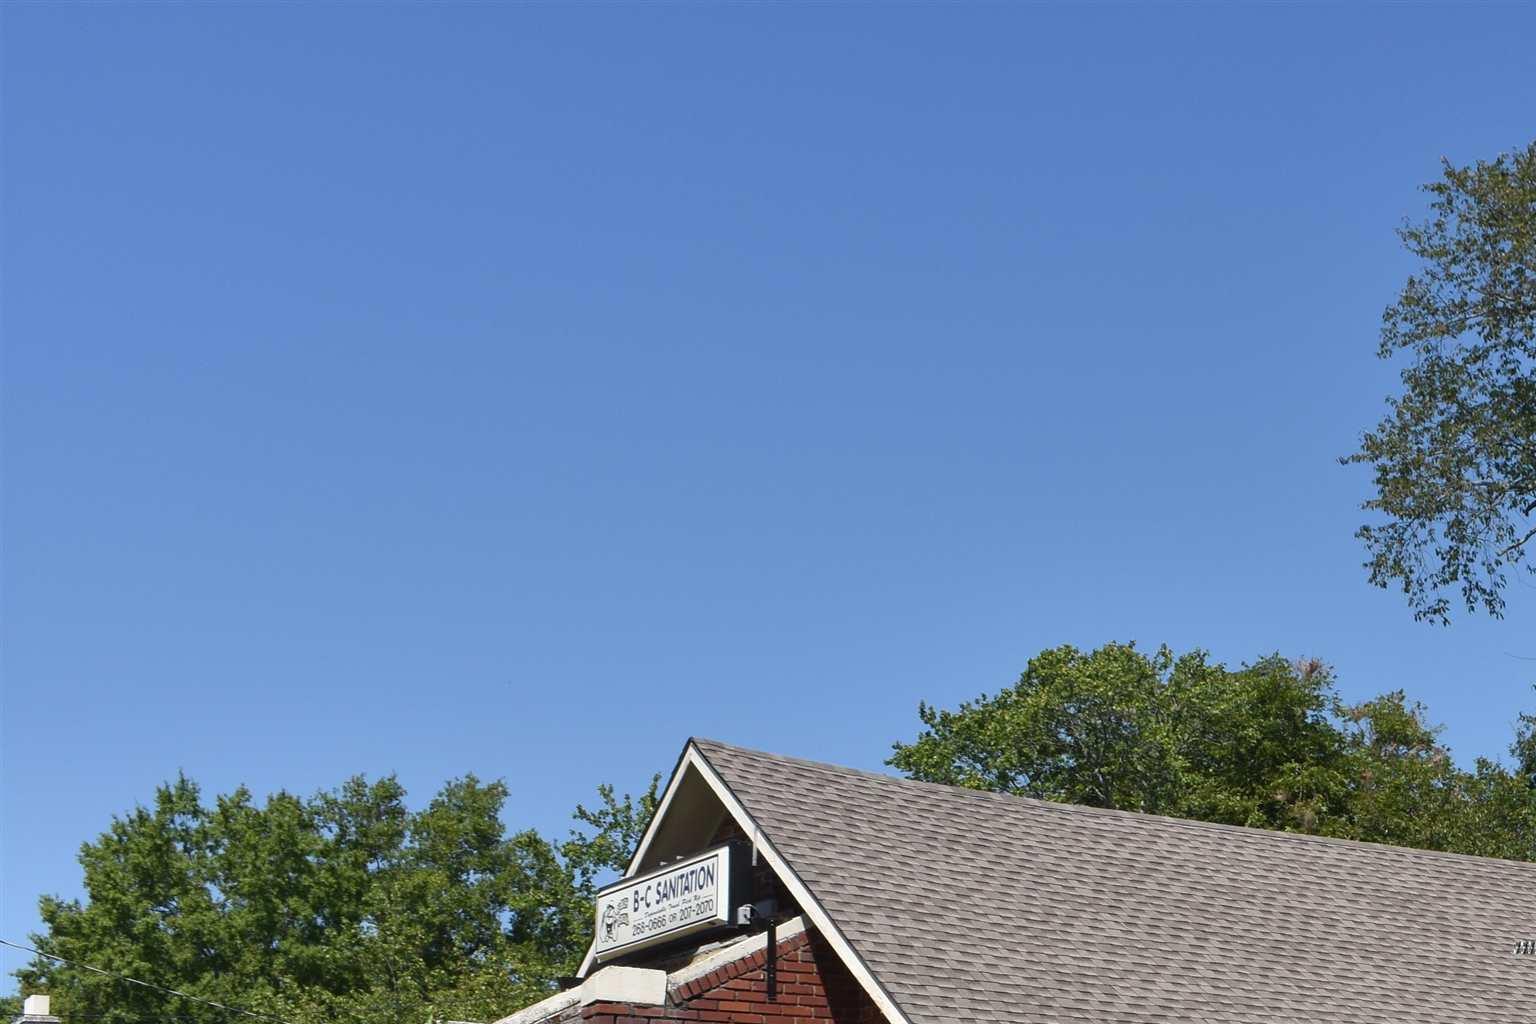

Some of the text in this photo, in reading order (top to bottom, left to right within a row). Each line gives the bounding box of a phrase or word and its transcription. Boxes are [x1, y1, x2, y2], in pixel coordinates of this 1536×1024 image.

[633, 885, 652, 912] B-C
[655, 862, 715, 905] SANITATION
[680, 898, 714, 921] 207-2070
